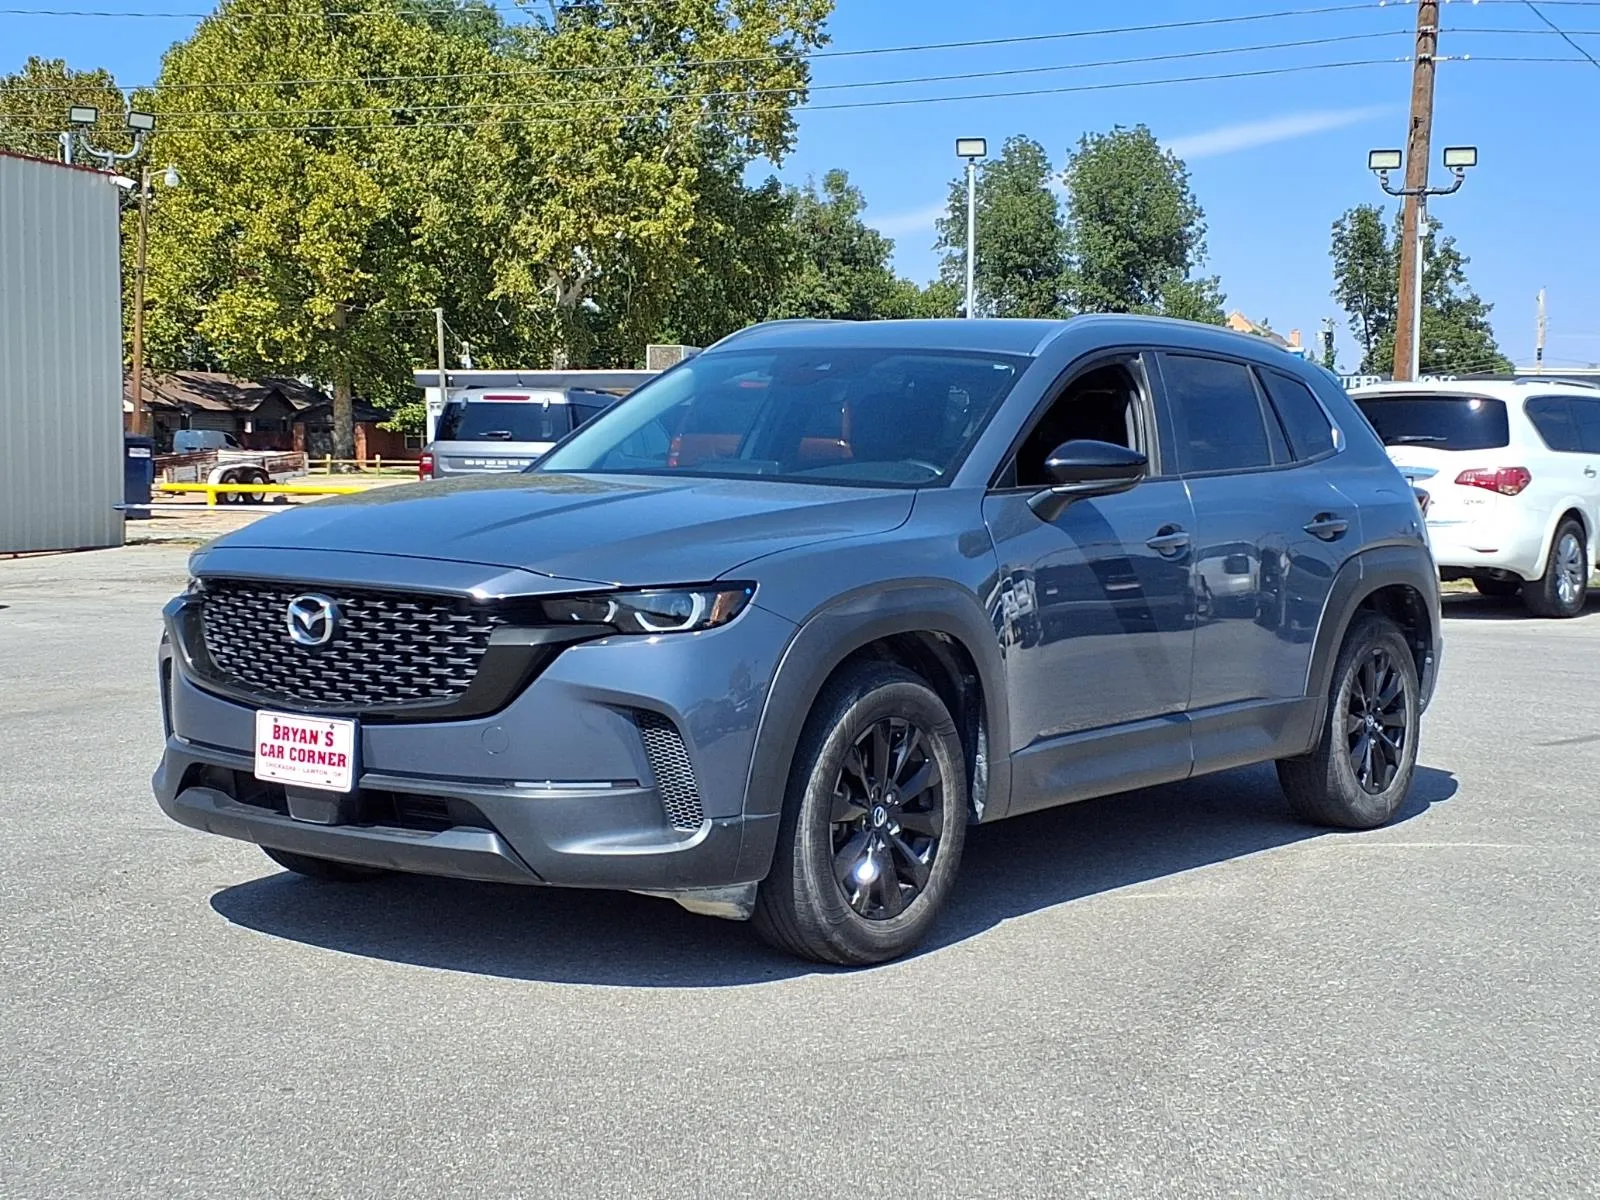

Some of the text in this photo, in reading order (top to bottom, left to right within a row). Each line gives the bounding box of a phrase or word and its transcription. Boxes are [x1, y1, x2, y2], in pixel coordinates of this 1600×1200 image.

[272, 724, 334, 747] BRYAN'S
[260, 742, 347, 768] CAR CORNER
